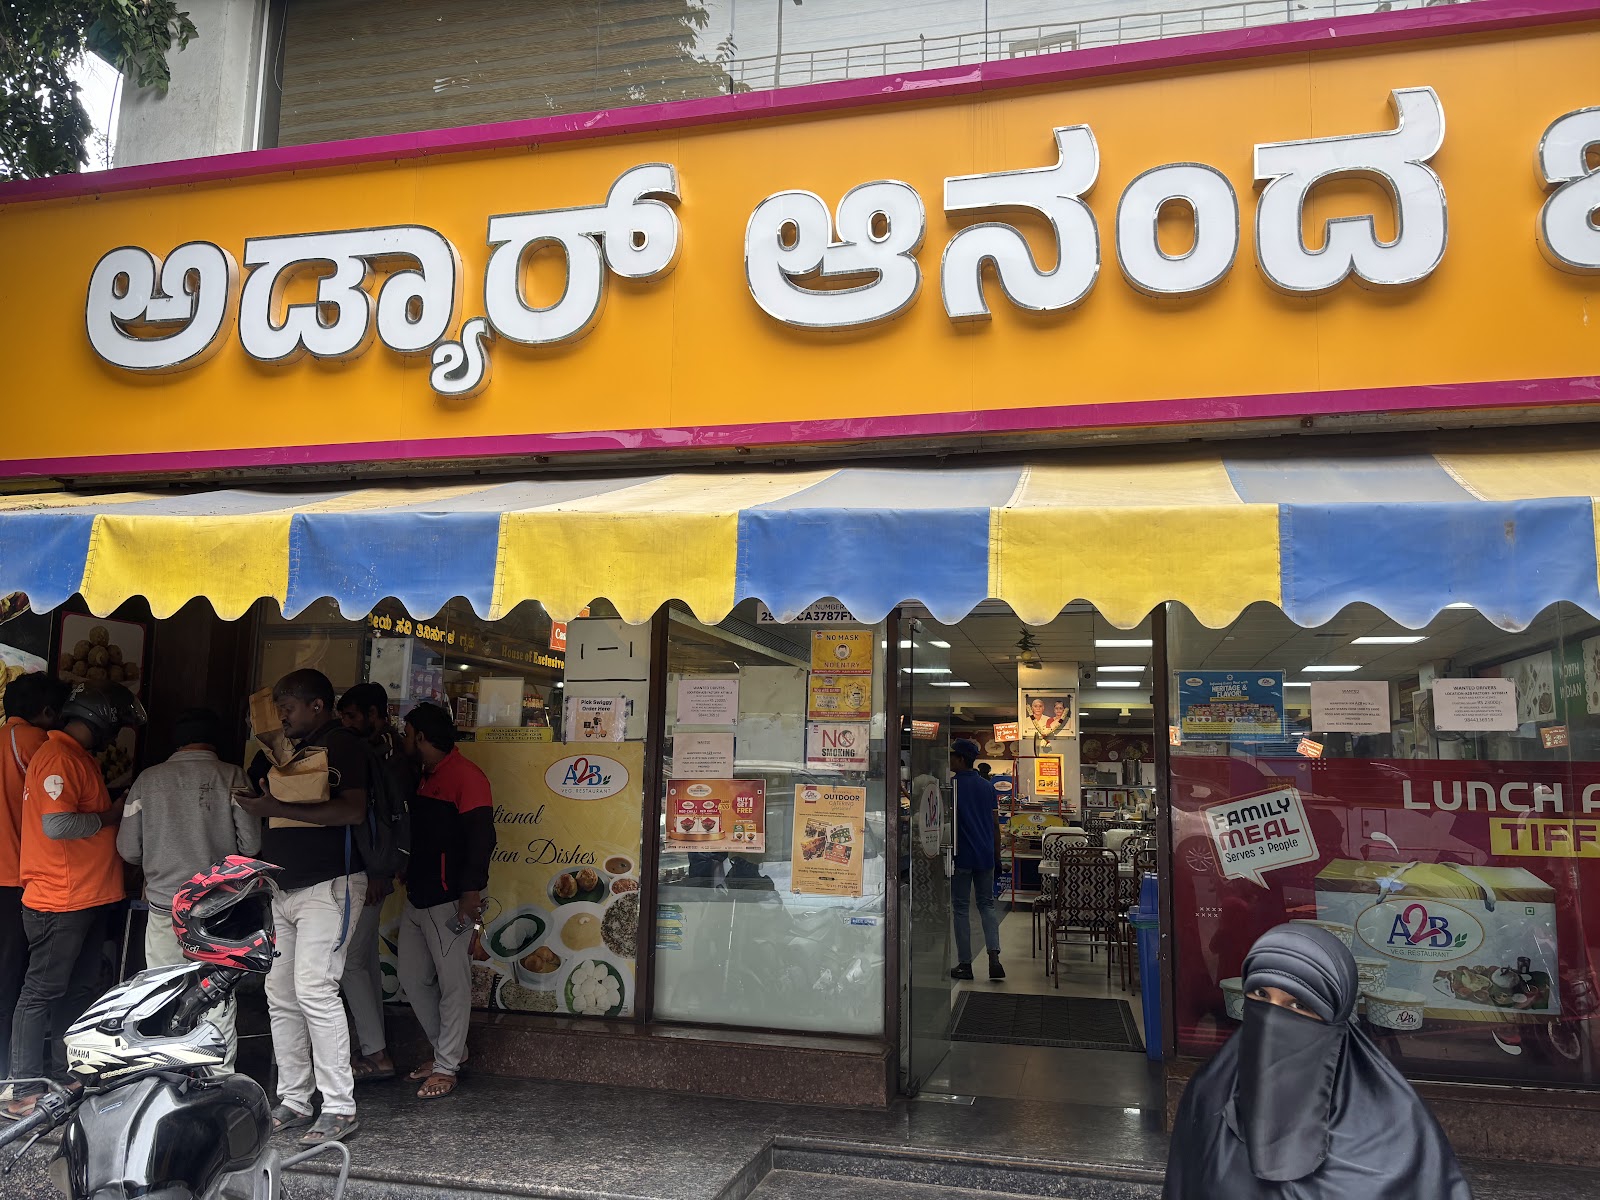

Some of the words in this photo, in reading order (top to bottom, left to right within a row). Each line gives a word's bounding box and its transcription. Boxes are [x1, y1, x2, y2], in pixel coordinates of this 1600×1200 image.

[86, 163, 681, 397] ಅಡ್ಯಾರ್
[745, 87, 1448, 327] ಆನಂದ
[502, 645, 523, 660] House
[525, 651, 533, 662] of
[533, 652, 565, 670] Exclusive
[822, 730, 855, 747] NO
[822, 748, 855, 757] SMOKING
[562, 757, 602, 785] A2B
[749, 797, 753, 807] 1
[1403, 780, 1564, 813] LUNCH
[1212, 798, 1290, 829] FAMILY
[1219, 818, 1300, 851] MEAL
[1501, 824, 1597, 852] TIFF
[525, 838, 598, 864] Dishes
[1225, 849, 1256, 863] Serves
[1259, 846, 1265, 855] 3
[1267, 838, 1299, 853] People
[1387, 903, 1453, 947] A2B
[1407, 949, 1450, 958] RESTAURANT
[68, 1047, 90, 1059] YAMAHA
